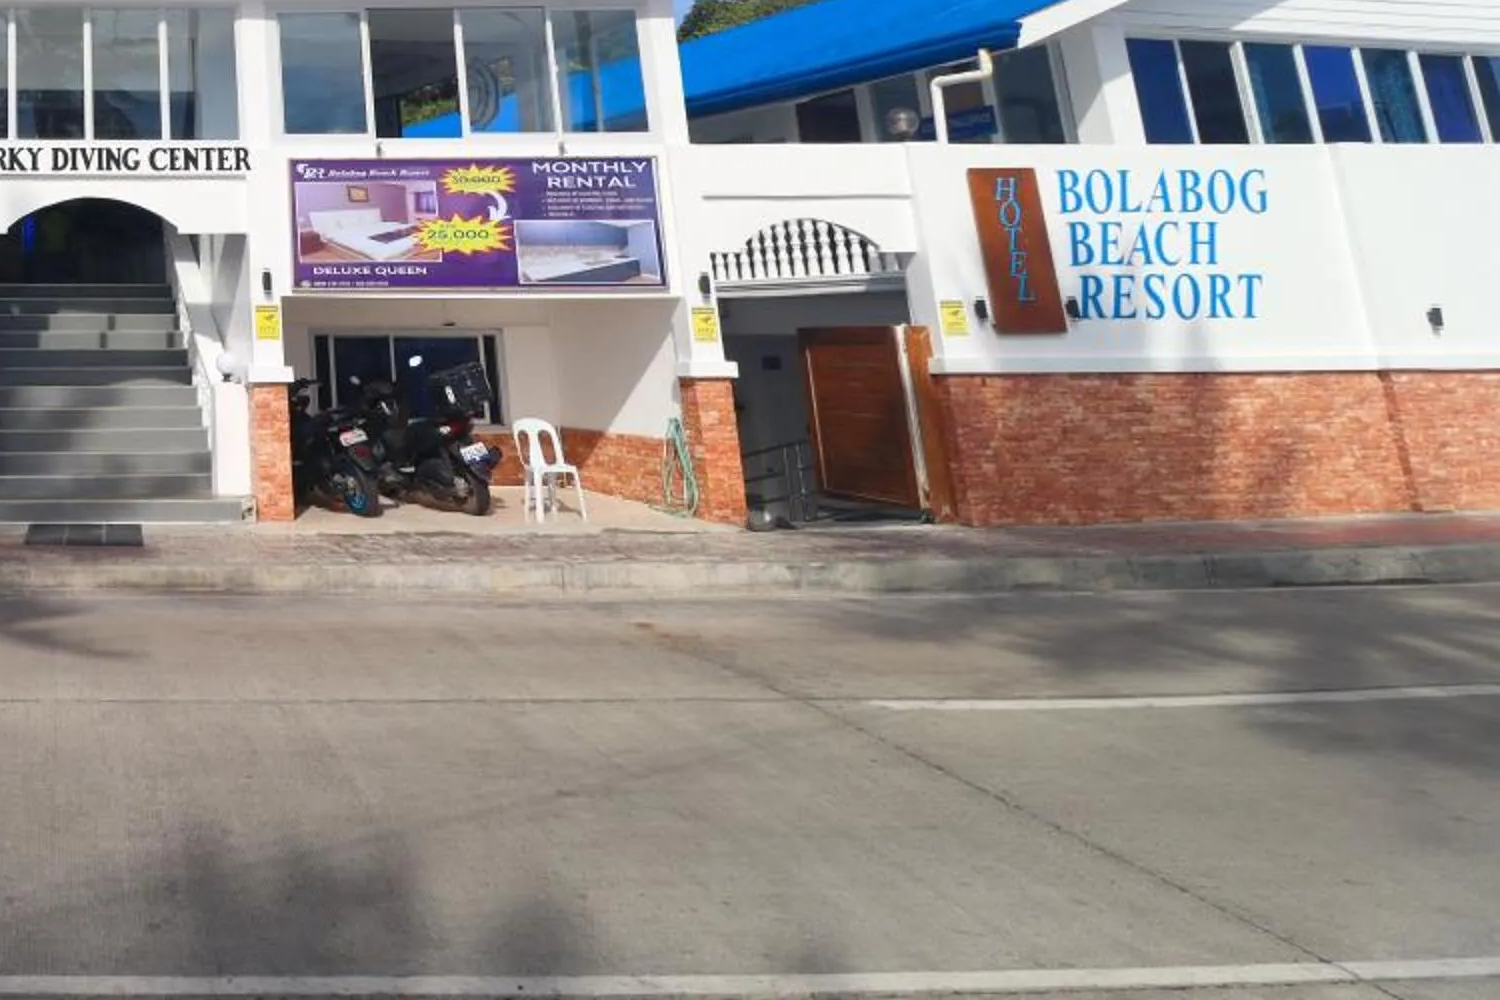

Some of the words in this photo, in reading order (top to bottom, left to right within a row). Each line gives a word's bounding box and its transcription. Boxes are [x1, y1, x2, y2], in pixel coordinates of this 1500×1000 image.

[51, 147, 142, 172] DIVING
[148, 147, 252, 172] CENTER
[531, 161, 648, 174] MONTHLY
[546, 175, 637, 189] RENTAL
[1055, 168, 1269, 214] BOLABOG
[994, 175, 1038, 306] HOTEL
[1066, 220, 1220, 267] BEACH
[312, 265, 372, 275] DELUXE
[374, 265, 429, 276] QUEEN
[1077, 273, 1264, 321] RESORT
